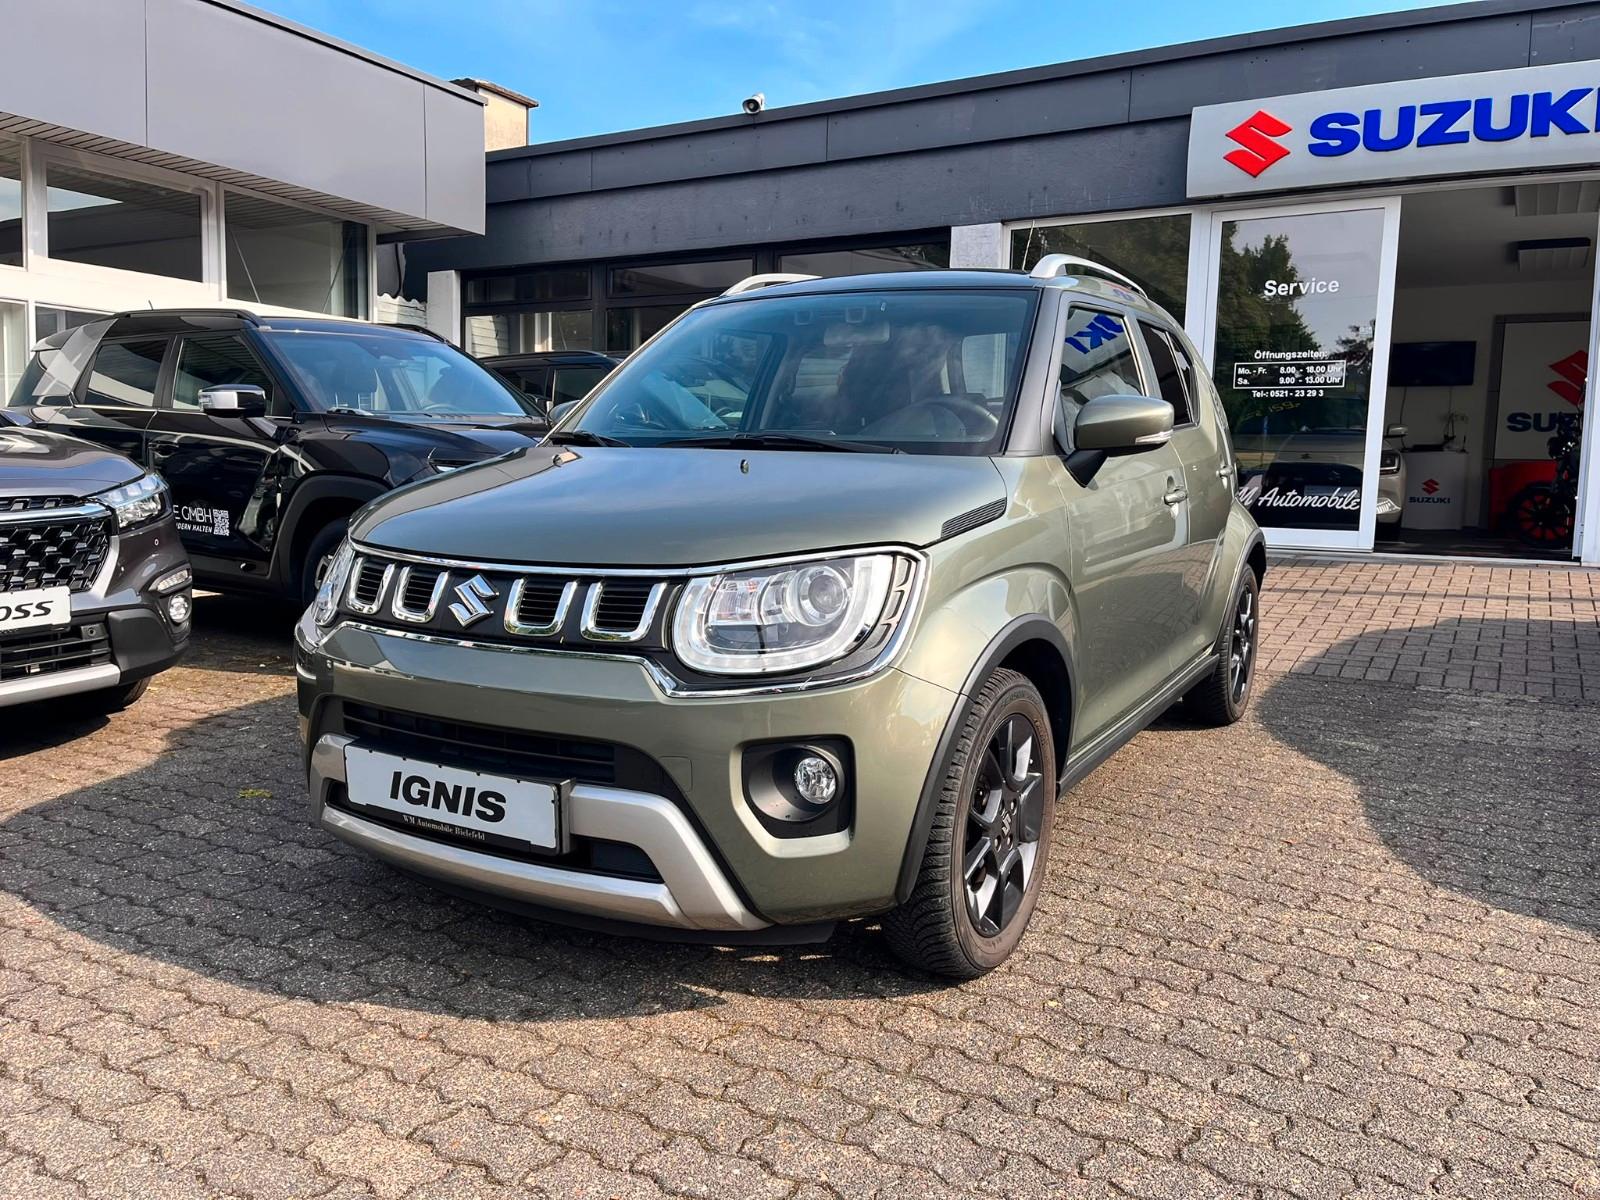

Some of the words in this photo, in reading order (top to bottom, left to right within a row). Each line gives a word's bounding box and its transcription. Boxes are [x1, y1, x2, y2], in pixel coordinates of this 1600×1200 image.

[1308, 87, 1600, 157] SUZUK
[1264, 278, 1340, 296] Service
[1254, 350, 1328, 360] Öffnungszeiten:
[1305, 376, 1325, 384] 13.00
[1258, 487, 1361, 510] Automobile
[1409, 496, 1450, 504] SUZUKI
[182, 506, 212, 523] GMBH
[192, 524, 212, 533] HALTEN
[389, 771, 506, 823] IGNIS
[402, 814, 415, 824] WM
[416, 819, 454, 834] Automobile
[454, 826, 485, 840] Bielefeld
